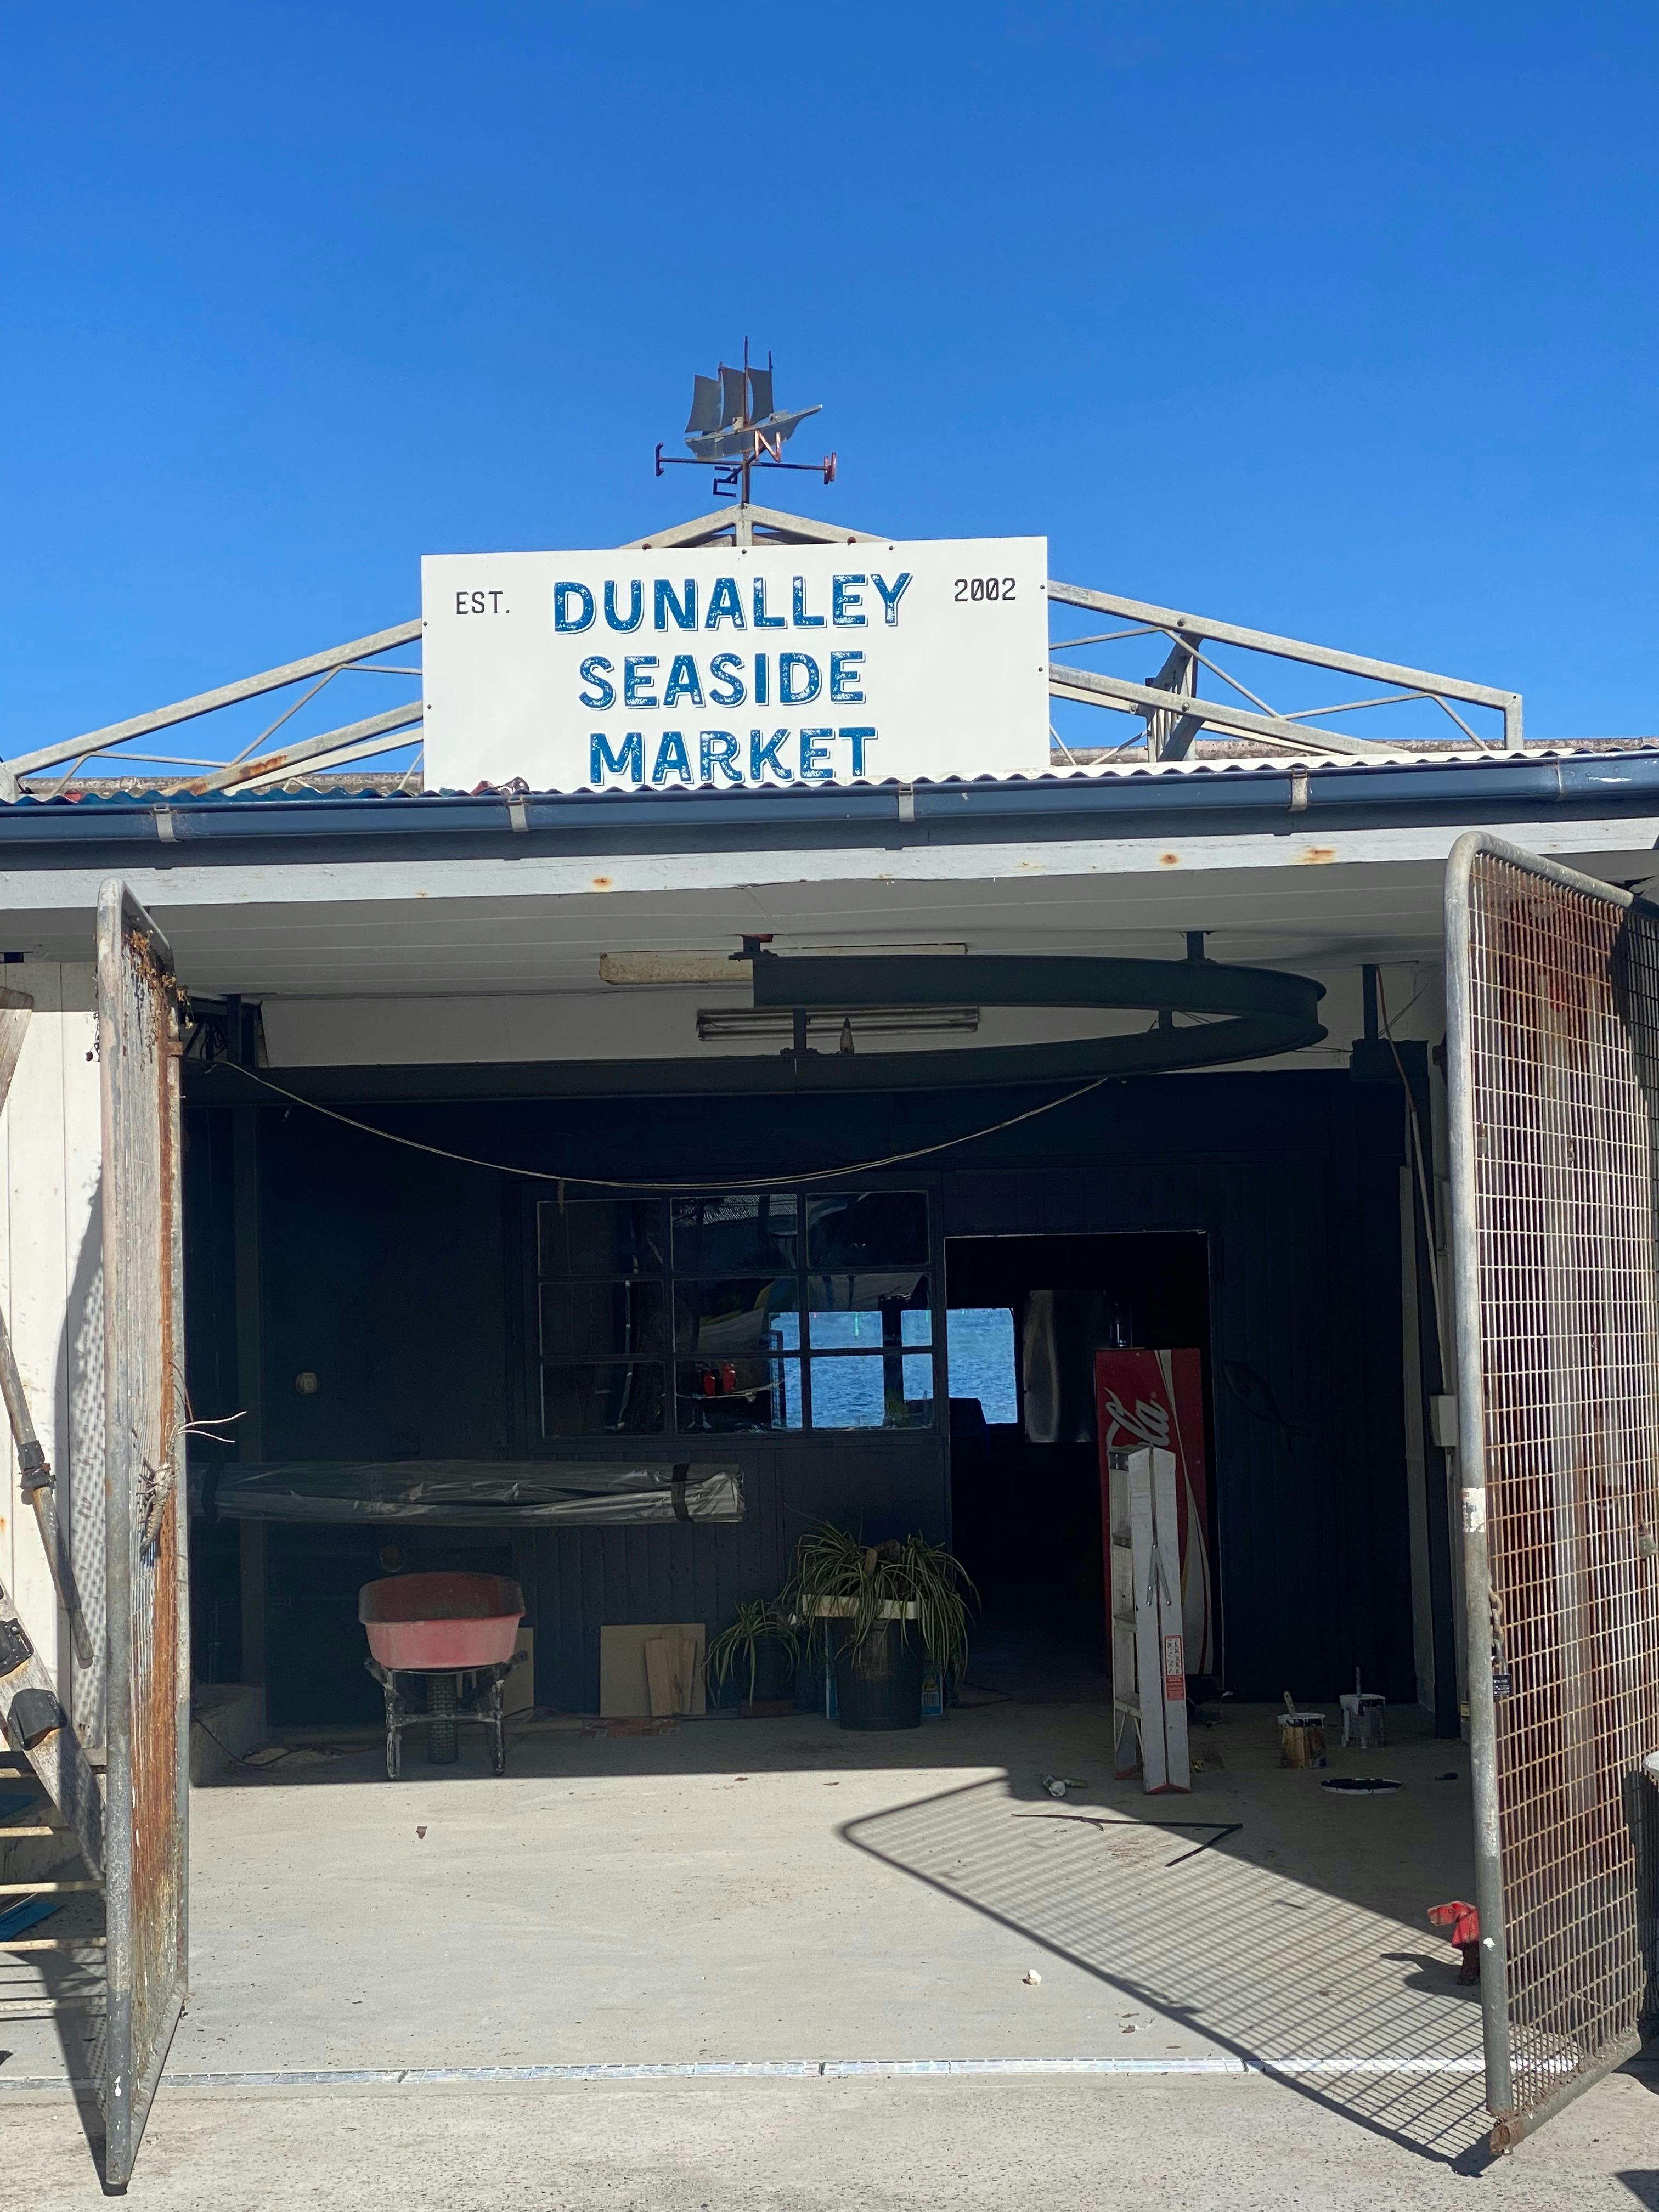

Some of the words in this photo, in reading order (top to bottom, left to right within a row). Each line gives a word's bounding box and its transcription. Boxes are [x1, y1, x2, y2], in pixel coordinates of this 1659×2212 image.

[456, 591, 510, 614] EST.
[554, 573, 913, 634] DUNALLEY
[955, 577, 1016, 602] 2002
[579, 651, 866, 711] SEASIDE
[590, 727, 879, 785] MARKET
